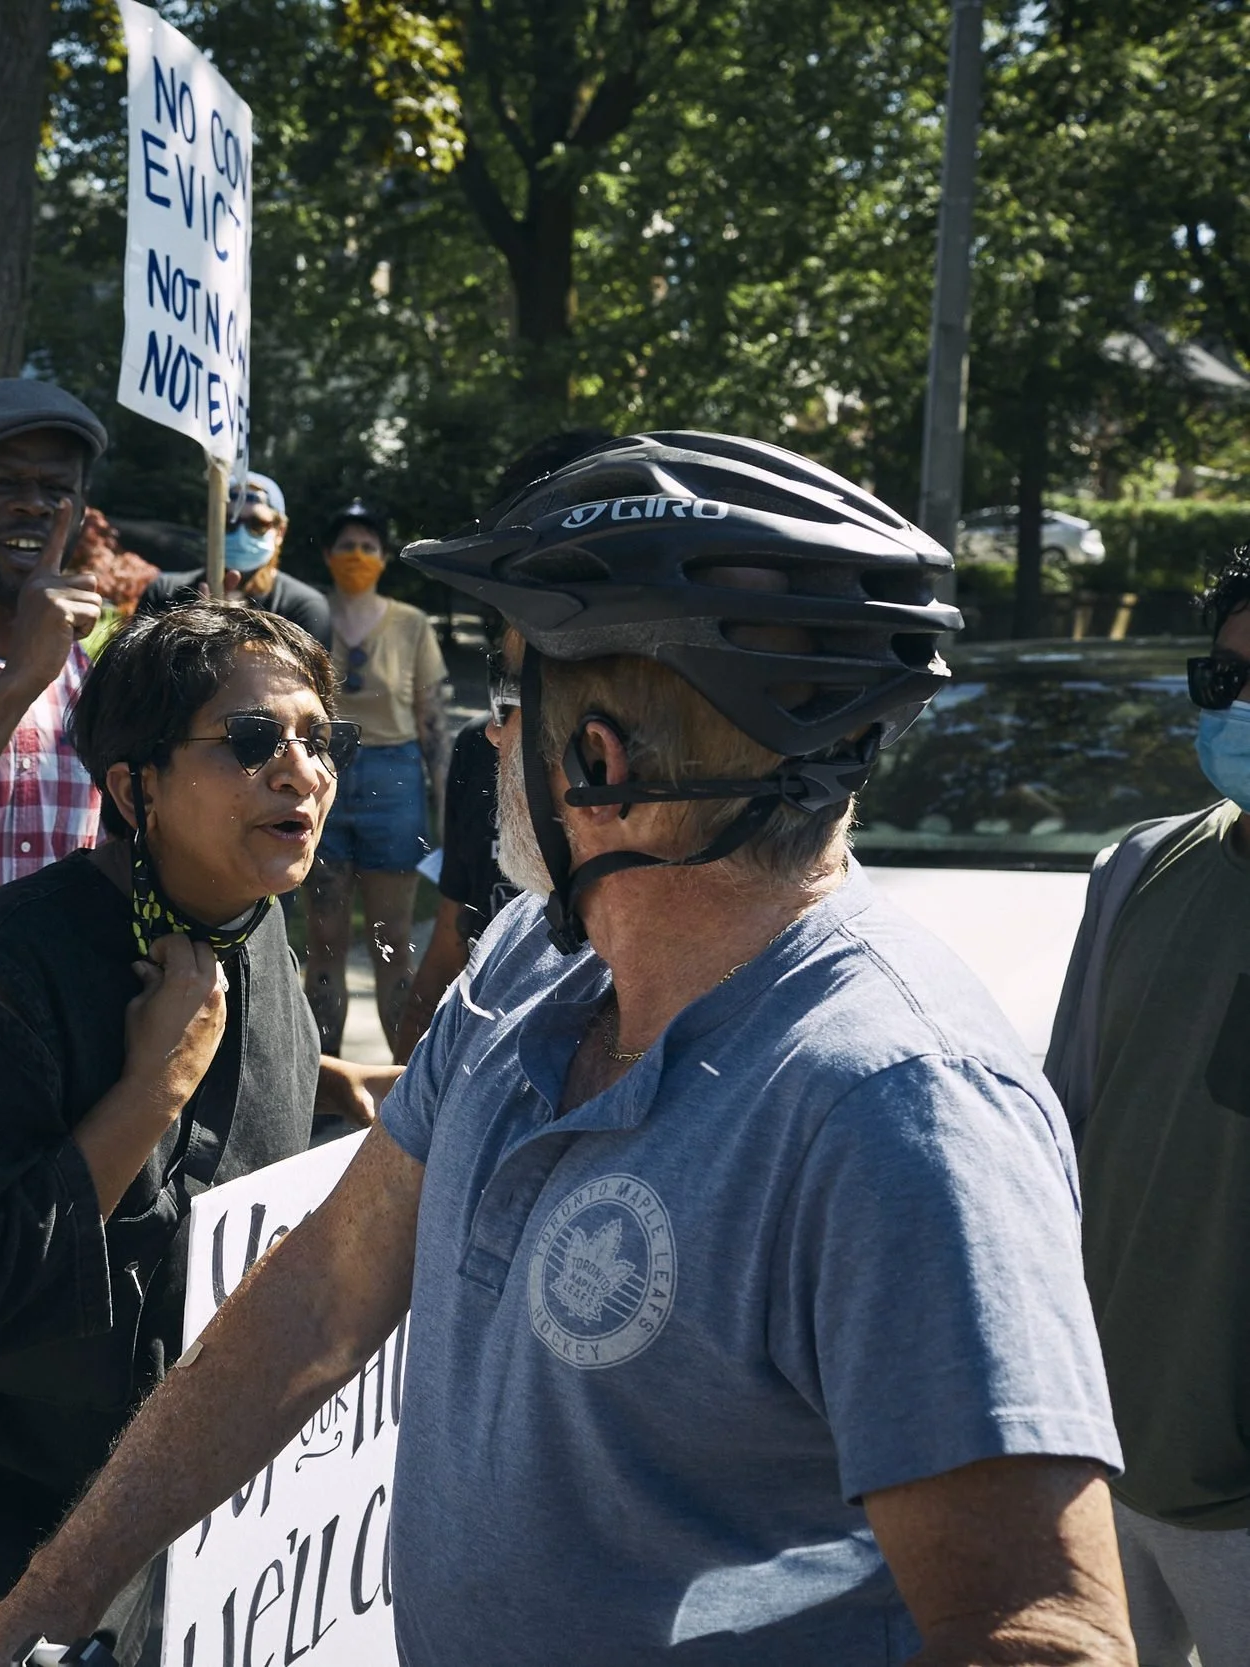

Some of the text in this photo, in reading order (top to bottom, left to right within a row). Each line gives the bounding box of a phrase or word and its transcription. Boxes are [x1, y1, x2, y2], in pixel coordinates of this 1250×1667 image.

[152, 56, 196, 144] NO
[148, 248, 200, 335] NOT
[139, 330, 203, 420] NOT
[611, 498, 730, 520] GIRO
[536, 1181, 670, 1333] TORONTO MAPLE LEAFS
[532, 1305, 600, 1361] HOCKEY
